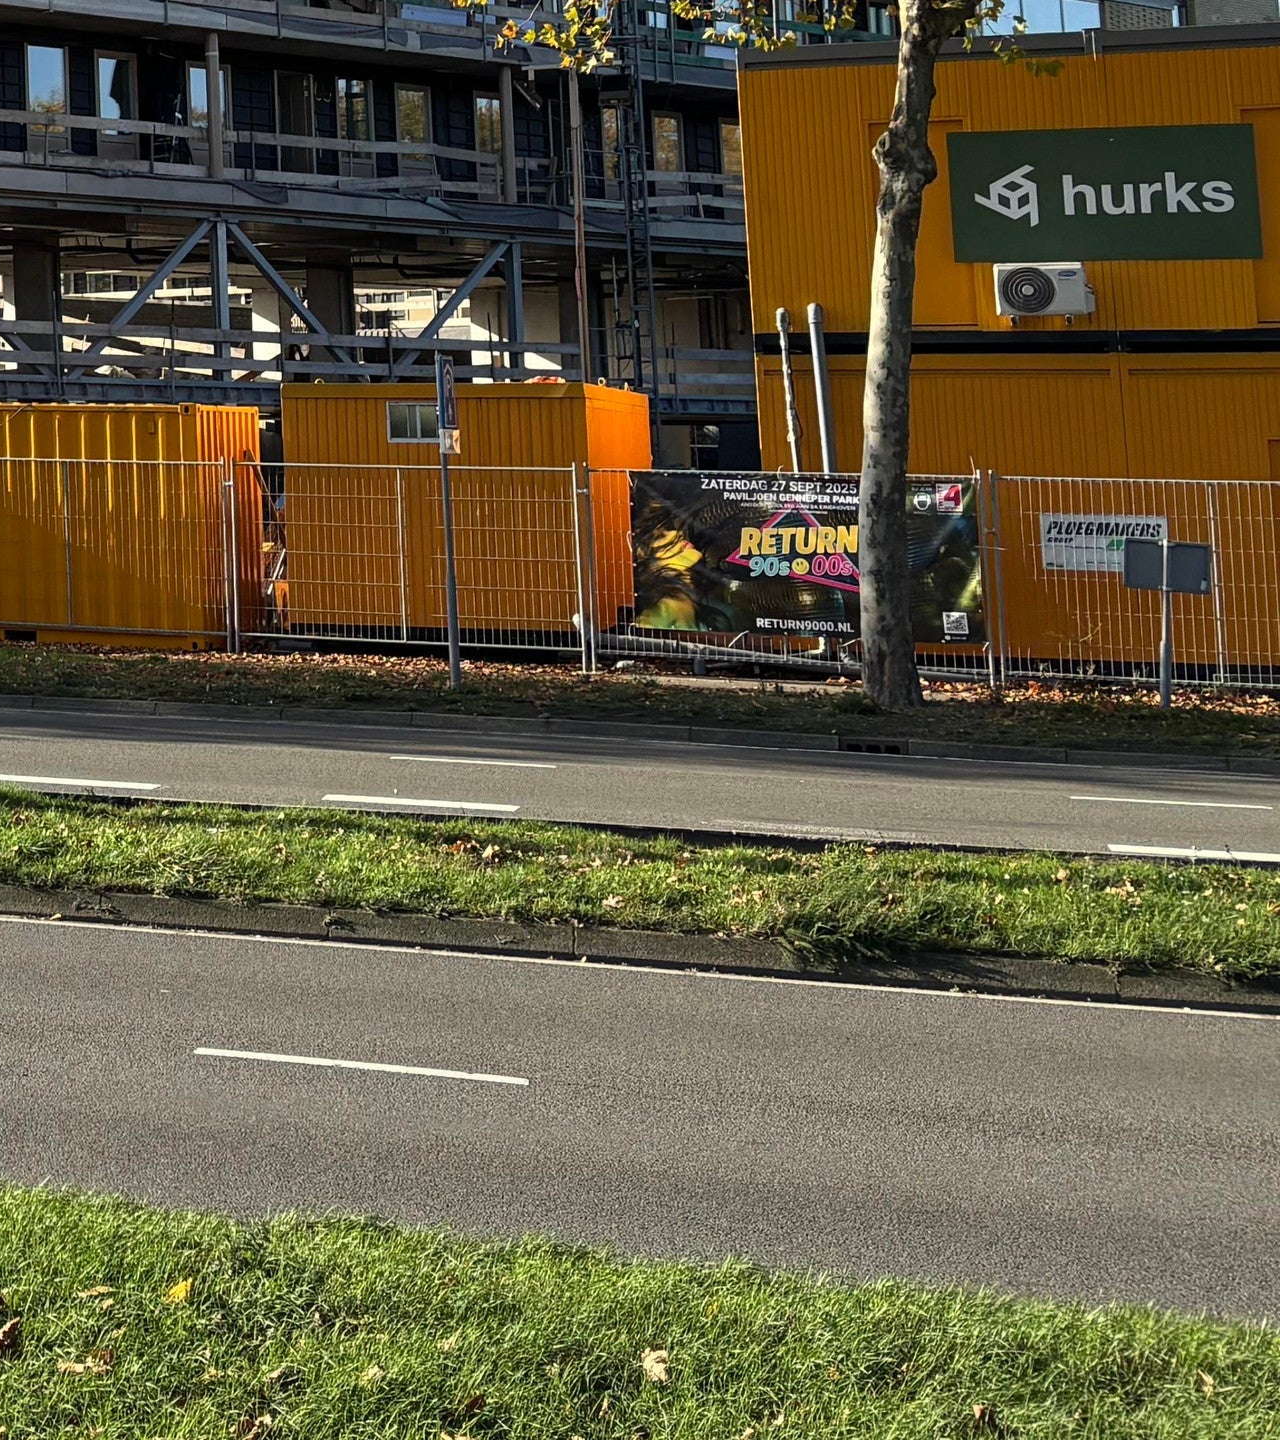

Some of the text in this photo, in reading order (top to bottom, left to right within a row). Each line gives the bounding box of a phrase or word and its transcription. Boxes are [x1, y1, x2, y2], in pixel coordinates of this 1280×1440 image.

[1062, 171, 1235, 216] hurks
[701, 479, 858, 494] ZATERDAG 27 SEPT 2025
[723, 491, 777, 501] PAVILJOEN
[779, 492, 830, 503] GENNEPER
[740, 525, 859, 556] RETURN
[749, 555, 853, 577] 90s 00s
[756, 617, 855, 633] RETURN9000.NL
